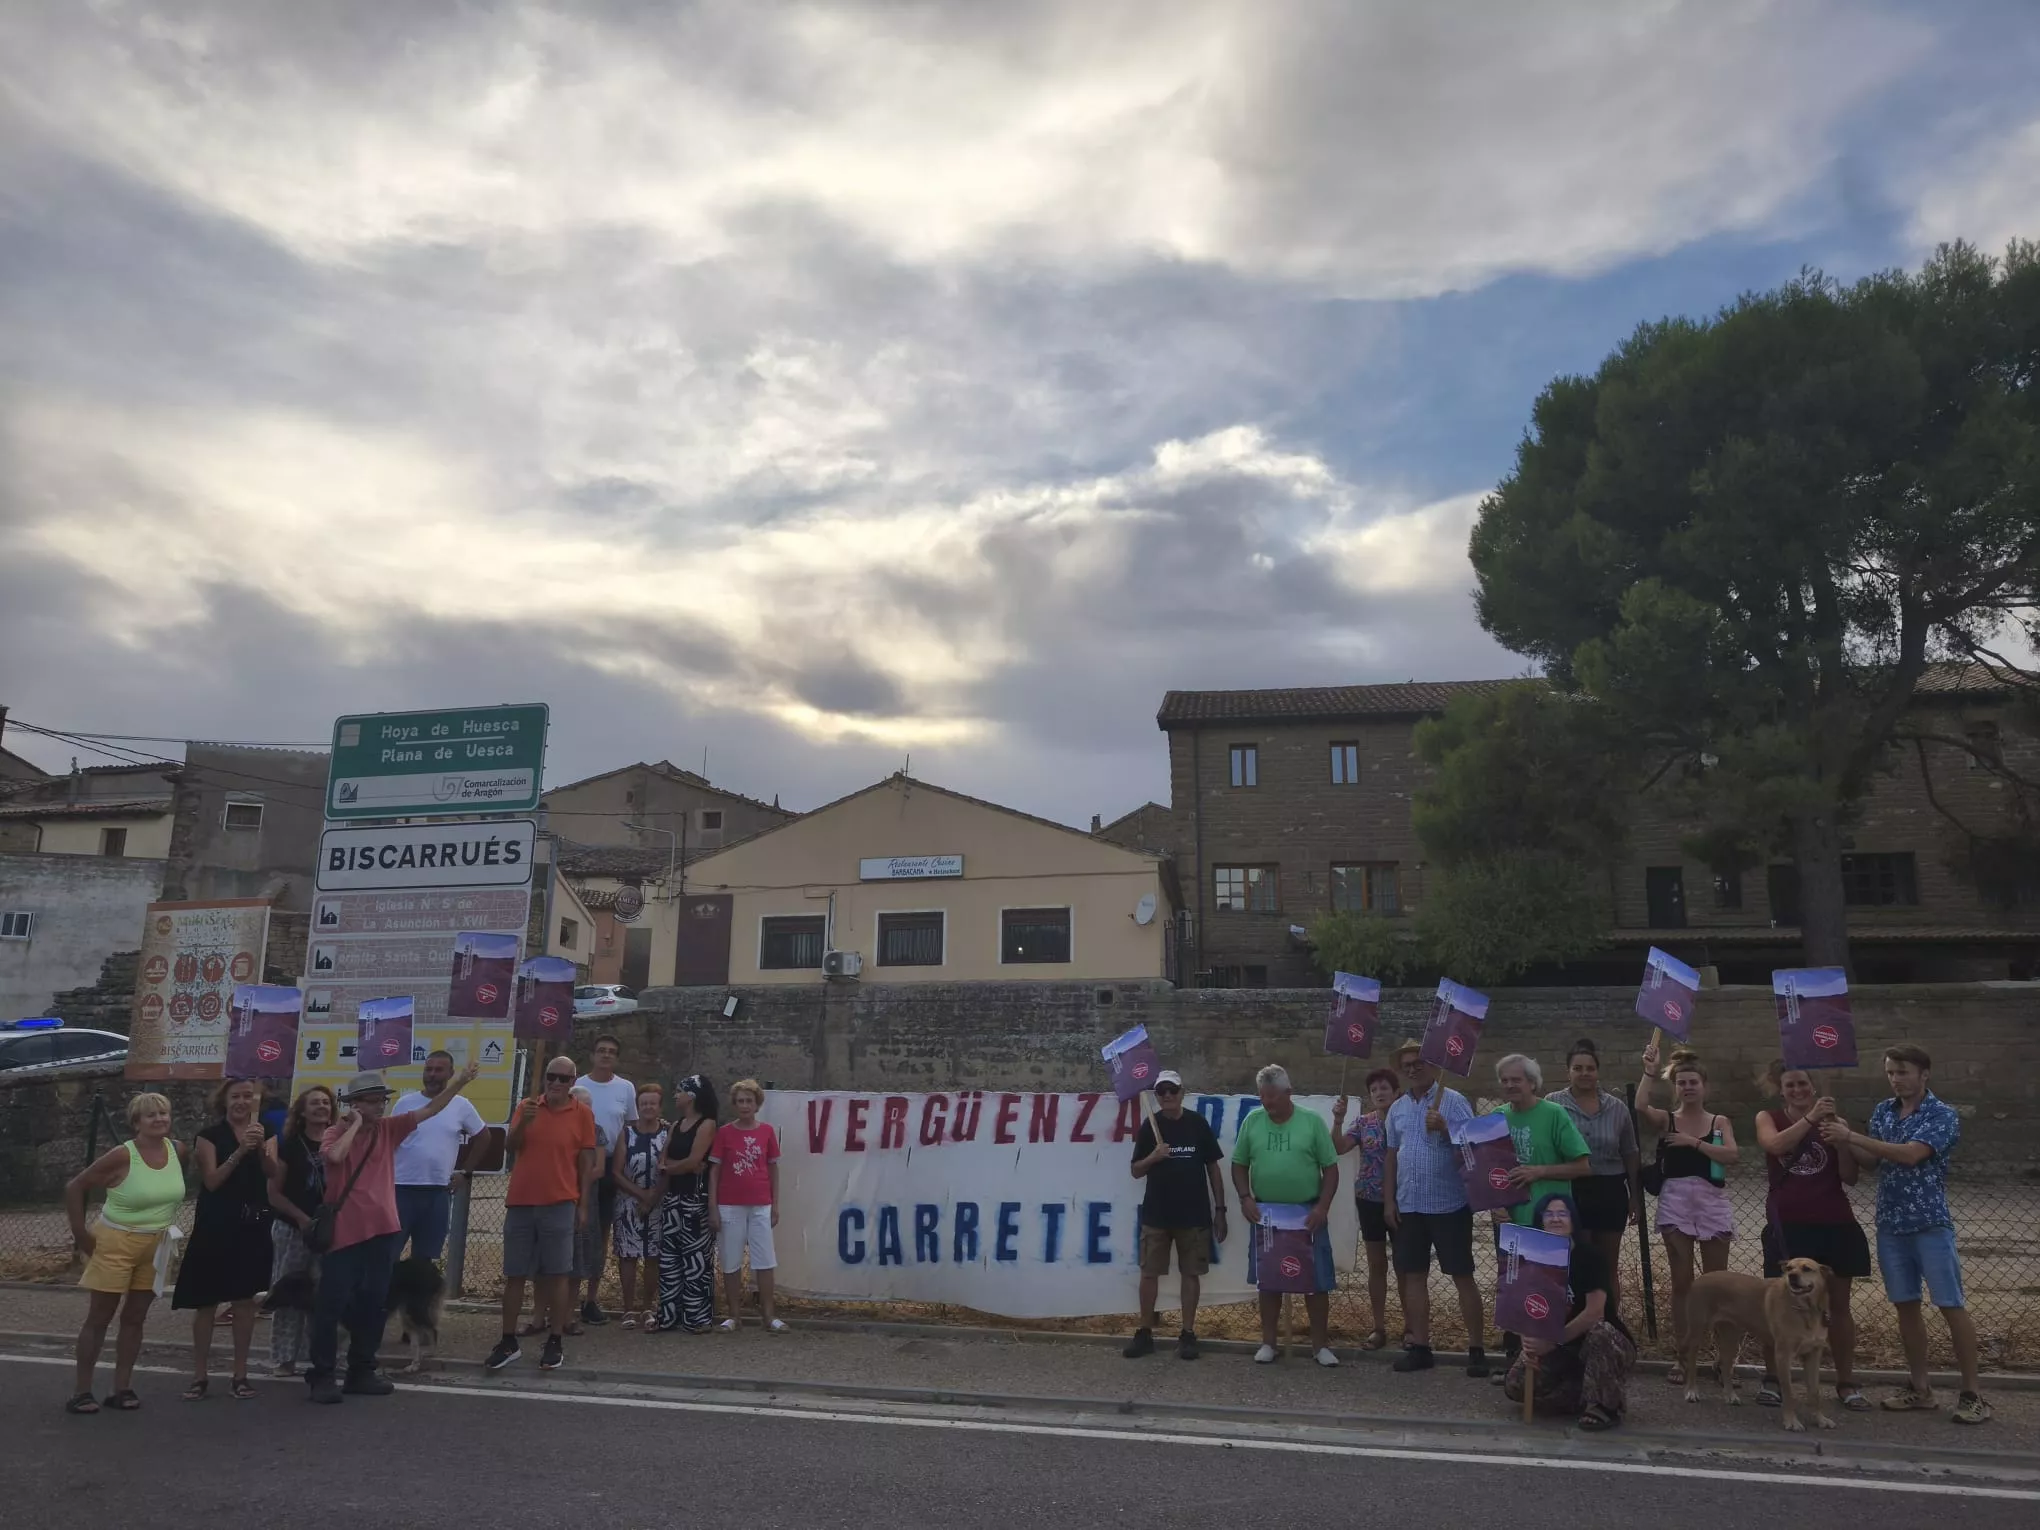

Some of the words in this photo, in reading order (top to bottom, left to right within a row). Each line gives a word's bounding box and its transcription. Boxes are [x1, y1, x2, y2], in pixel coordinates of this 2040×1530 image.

[381, 724, 419, 739] Hoya
[431, 723, 449, 736] de
[463, 720, 520, 733] Huesca
[381, 750, 423, 763] Plana
[434, 747, 453, 759] de
[466, 744, 514, 757] Uesca
[464, 776, 527, 788] Comarcalización
[461, 789, 472, 797] de
[474, 787, 503, 799] Aragón
[328, 836, 521, 870] BISCARRUÉS
[375, 900, 414, 912] Iglesia
[458, 899, 473, 909] de
[363, 919, 377, 930] La
[384, 950, 420, 962] Santa
[807, 1090, 1142, 1154] VERGÜENZA
[837, 1201, 1219, 1265] CARRETE
